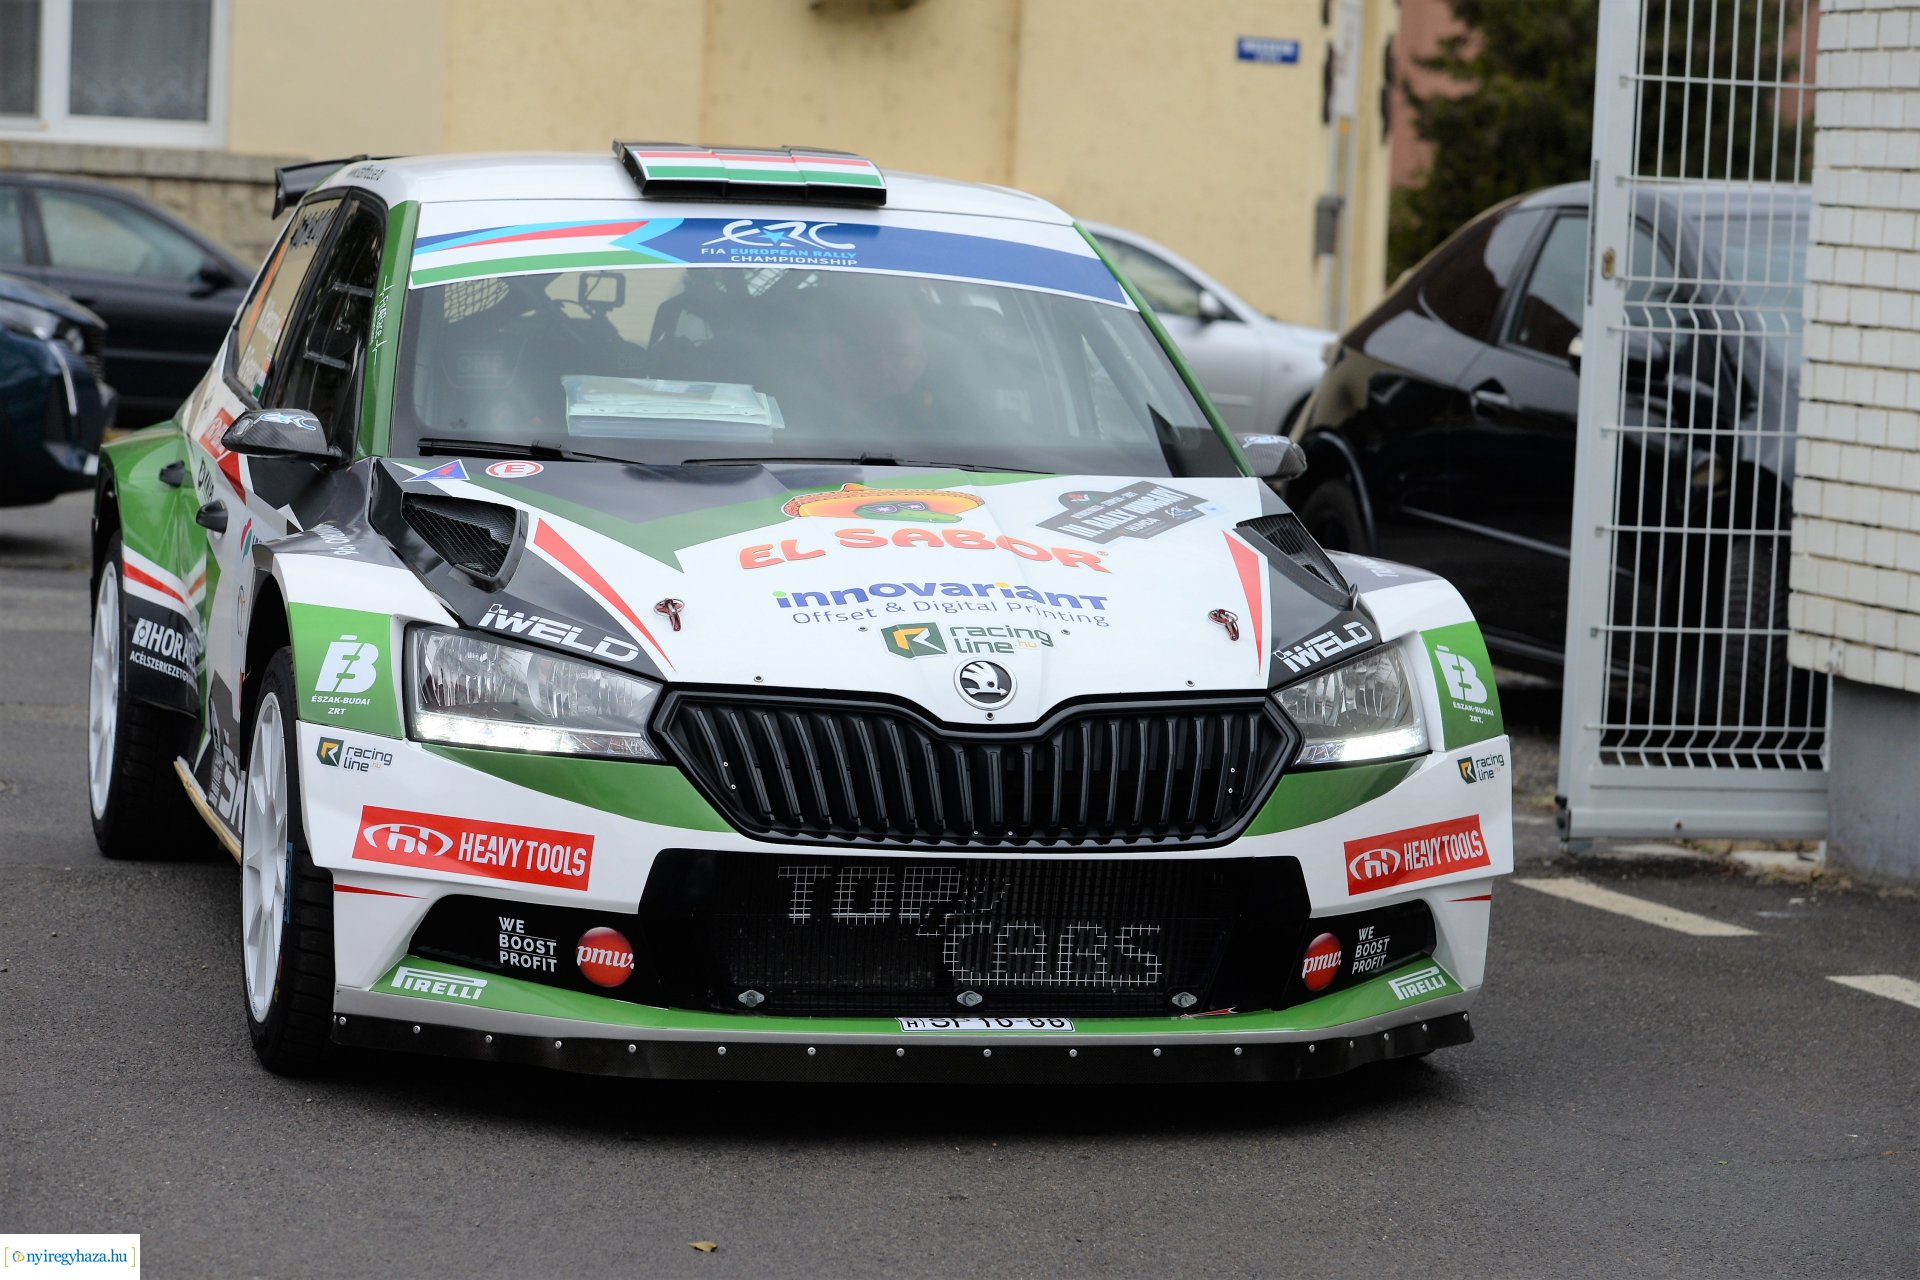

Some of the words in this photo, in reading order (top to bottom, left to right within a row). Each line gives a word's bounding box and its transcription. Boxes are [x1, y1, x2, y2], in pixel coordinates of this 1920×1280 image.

[730, 248, 809, 257] EUROPEAN
[813, 250, 857, 259] RALLY
[730, 256, 858, 266] CHAMPIONSHIP
[1081, 508, 1138, 530] RALLY
[1120, 485, 1190, 515] HUNGARY
[739, 539, 826, 570] EL
[834, 527, 1113, 574] SABOR
[792, 606, 878, 625] Offset
[885, 601, 906, 613] &
[914, 600, 998, 615] Digital
[1009, 601, 1110, 628] Printing
[949, 625, 1054, 648] racing
[311, 695, 371, 705] ÉSZAK-BUDAI
[327, 707, 347, 715] ZRT
[346, 746, 393, 766] racing
[1476, 754, 1505, 768] racing
[457, 831, 525, 868] HEAVY
[526, 840, 588, 877] TOOLS
[1403, 836, 1443, 871] HEAVY
[1441, 829, 1484, 863] TOOLS
[777, 865, 961, 926] TOP
[498, 916, 526, 934] WE
[1358, 925, 1375, 941] WE
[499, 934, 557, 956] BOOST
[941, 919, 1163, 988] CARS
[1355, 938, 1390, 959] BOOST
[499, 951, 558, 973] PROFIT
[1351, 954, 1387, 975] PROFIT
[390, 966, 489, 1001] PIRELLI
[1388, 966, 1447, 1001] PIRELLI
